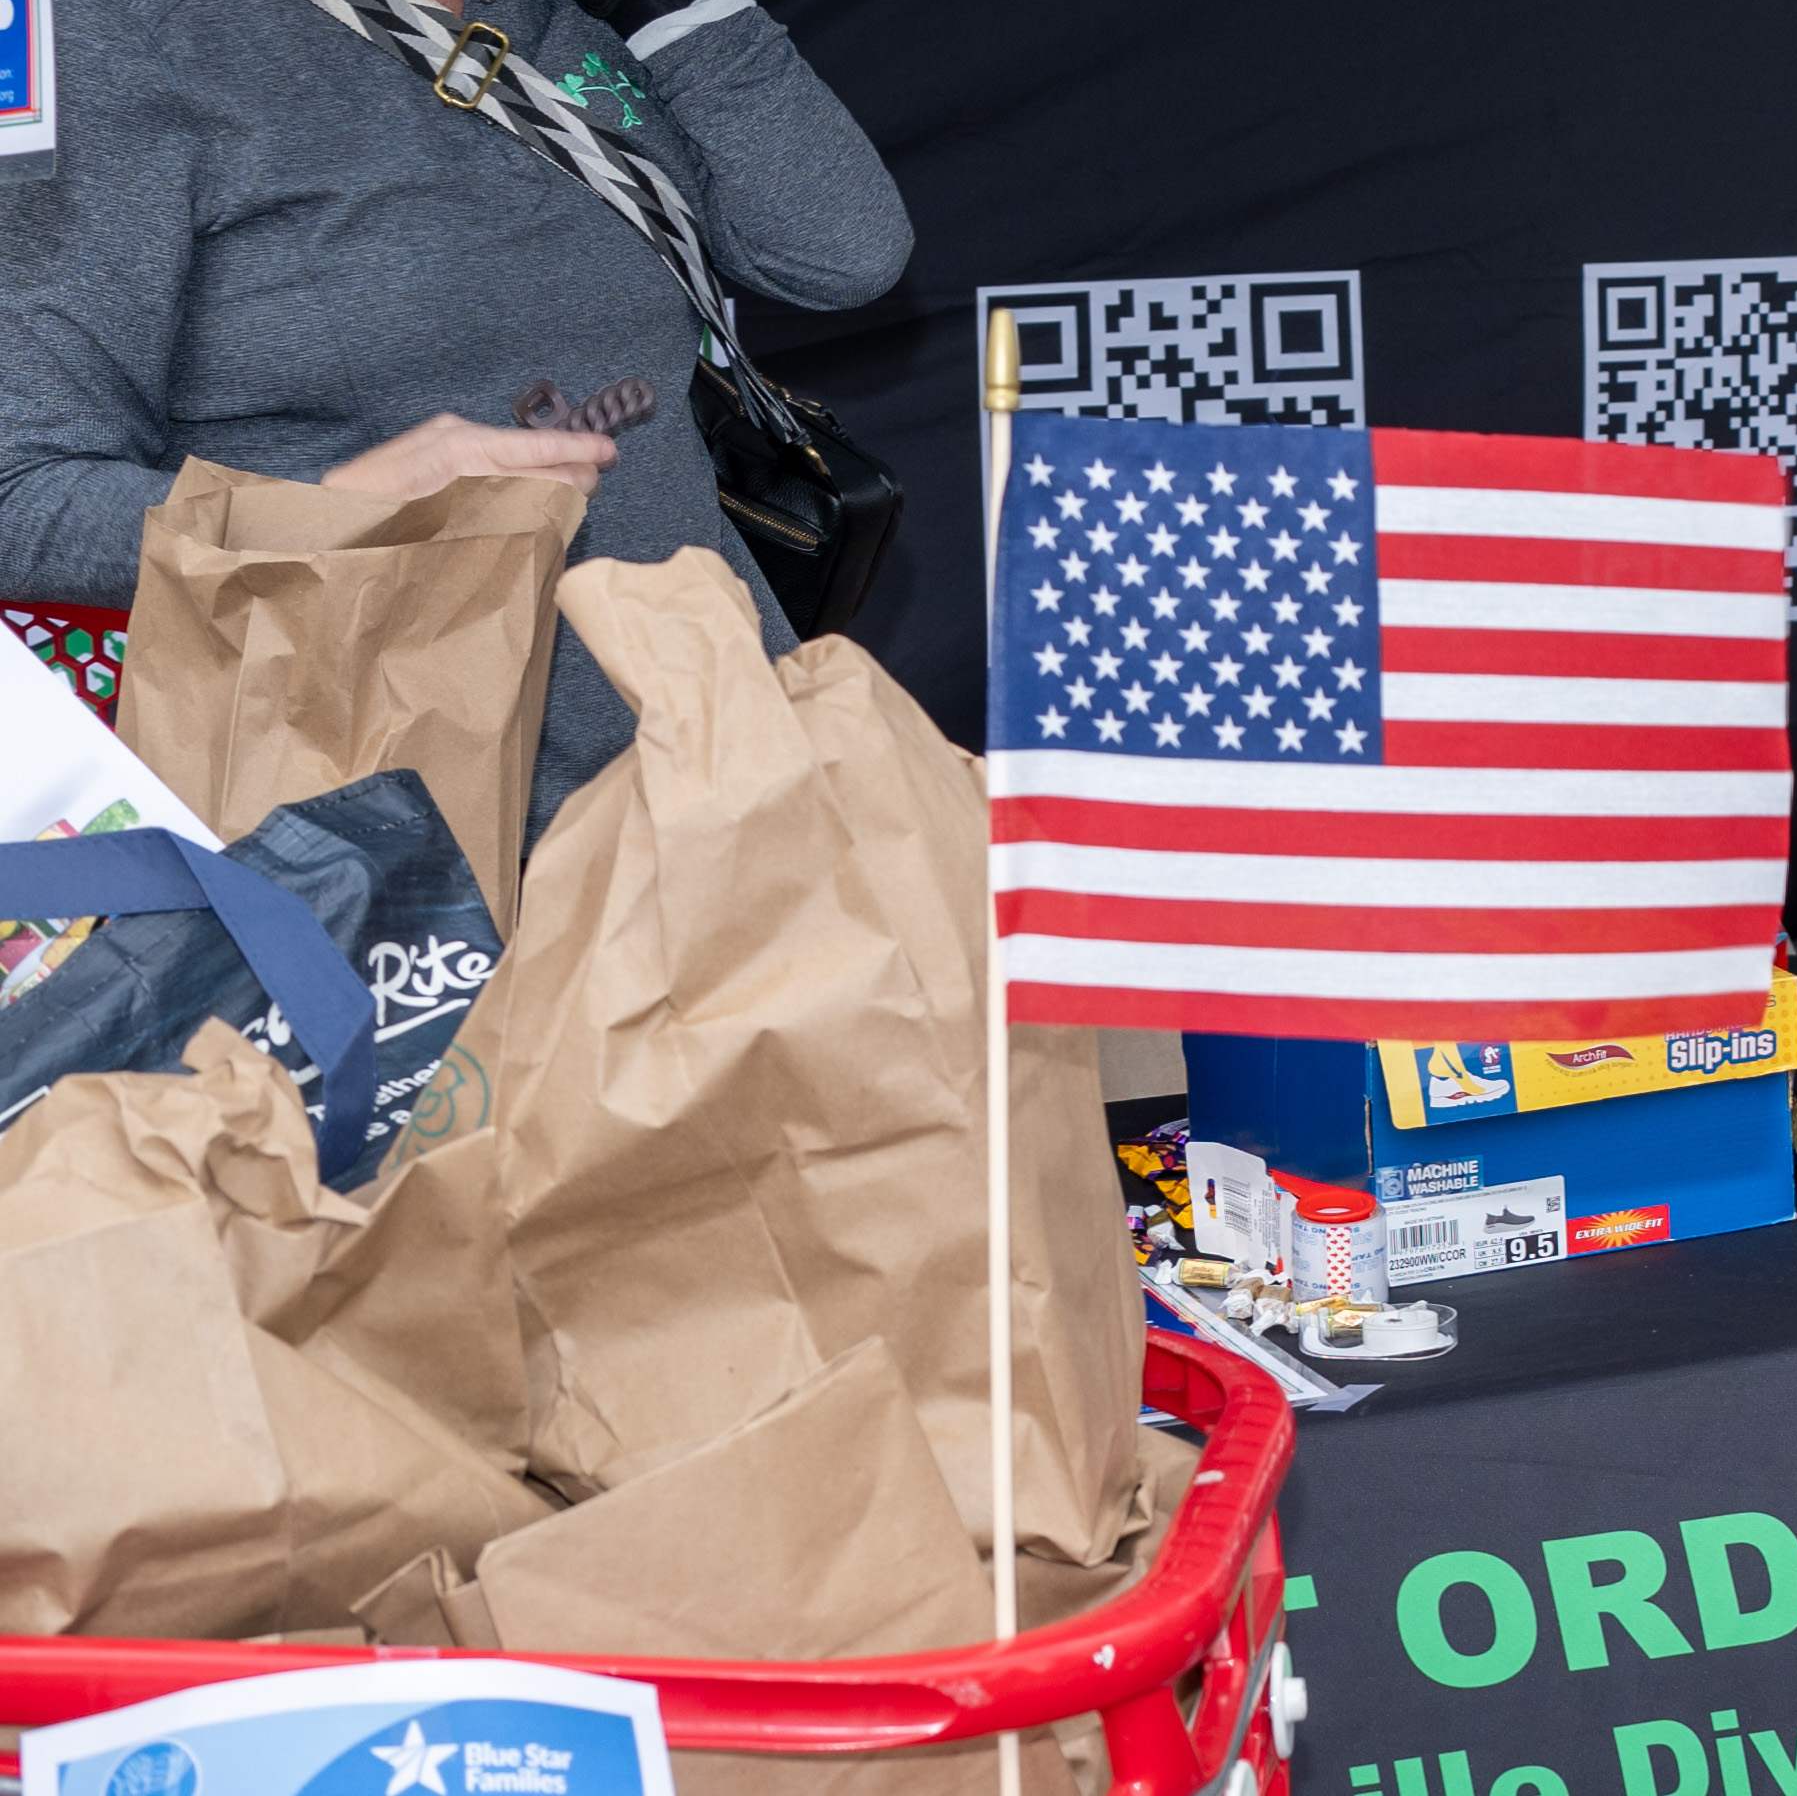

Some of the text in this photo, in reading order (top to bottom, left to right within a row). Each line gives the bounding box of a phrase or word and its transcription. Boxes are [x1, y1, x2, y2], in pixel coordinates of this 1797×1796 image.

[368, 934, 500, 1027] Rite
[1670, 1031, 1775, 1072] Slip-ins
[1407, 1159, 1479, 1183] MACHINE
[1408, 1174, 1479, 1196] WASHABLE
[1575, 1216, 1665, 1241] EXTRA WIDE FIT
[1509, 1233, 1555, 1263] 9.5
[464, 1741, 574, 1771] Blue Star
[464, 1766, 568, 1796] Families
